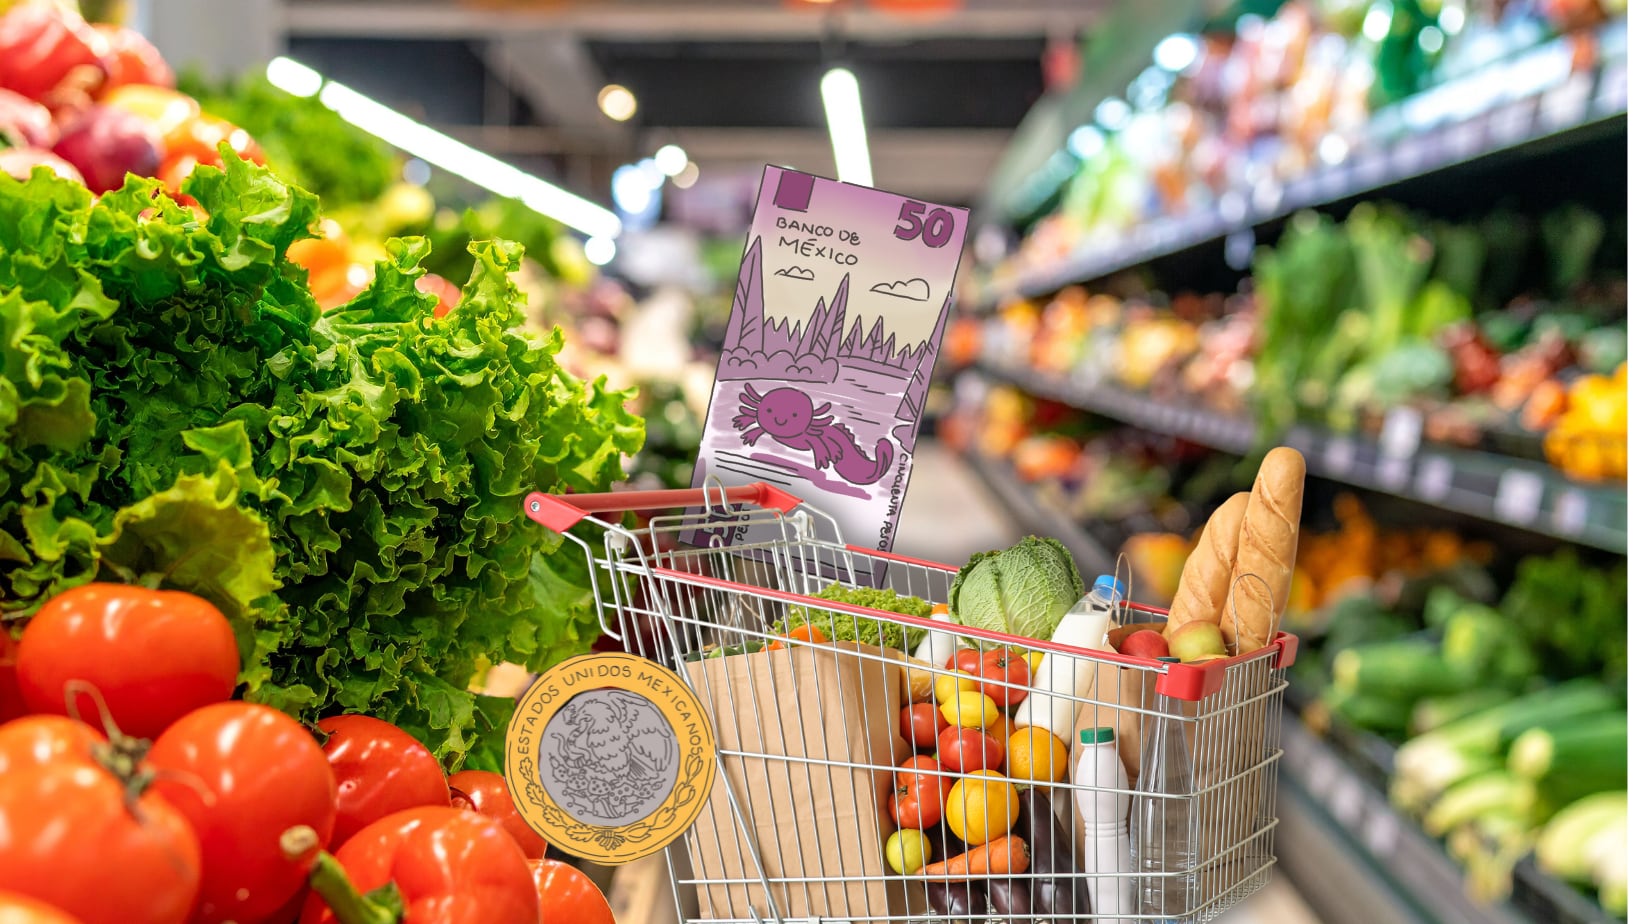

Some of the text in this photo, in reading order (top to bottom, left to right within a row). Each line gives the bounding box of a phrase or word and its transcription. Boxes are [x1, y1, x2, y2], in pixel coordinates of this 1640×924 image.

[776, 216, 862, 246] BANCO DE
[893, 199, 955, 248] 50
[778, 236, 859, 266] MÉXICO
[887, 453, 909, 516] CINCUENTA
[517, 664, 704, 757] ESTADOS UNIDOS MEXICANOS
